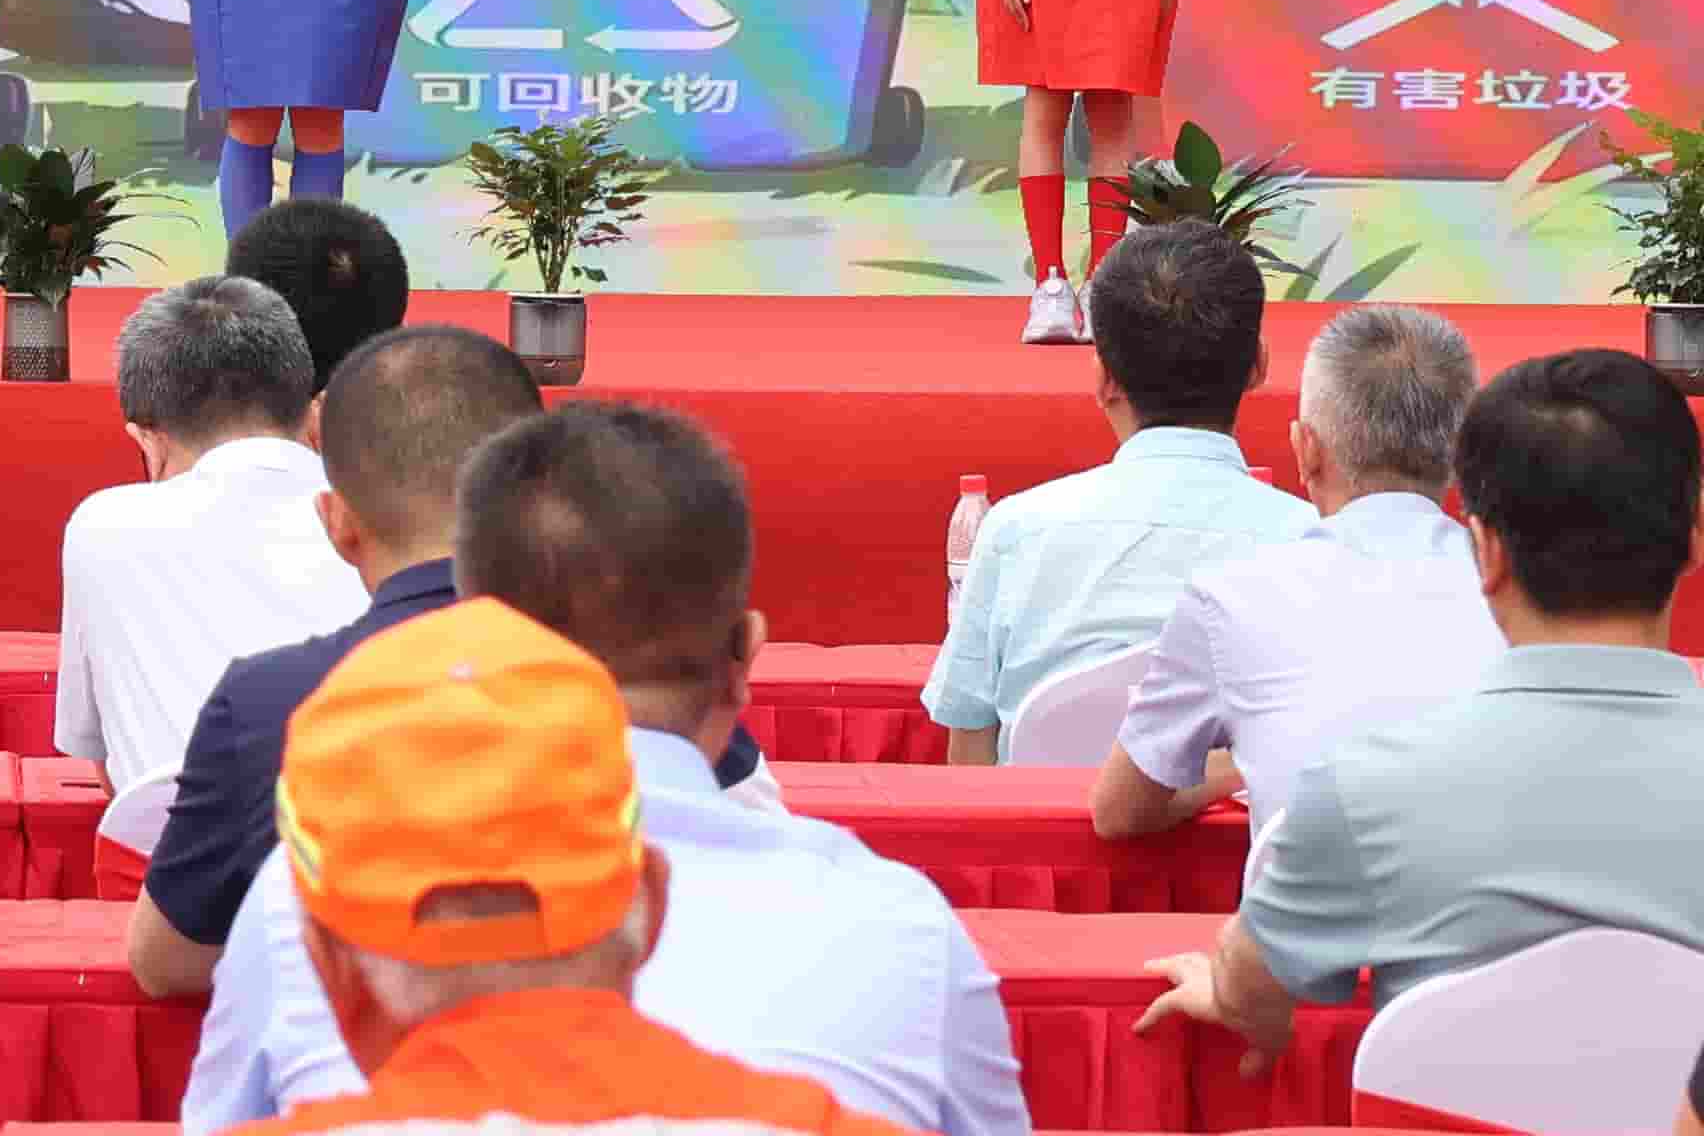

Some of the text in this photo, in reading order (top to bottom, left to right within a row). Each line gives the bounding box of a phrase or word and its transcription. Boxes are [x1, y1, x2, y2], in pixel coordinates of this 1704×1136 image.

[411, 71, 740, 119] 可回收物
[1308, 66, 1634, 111] 有害垃圾
